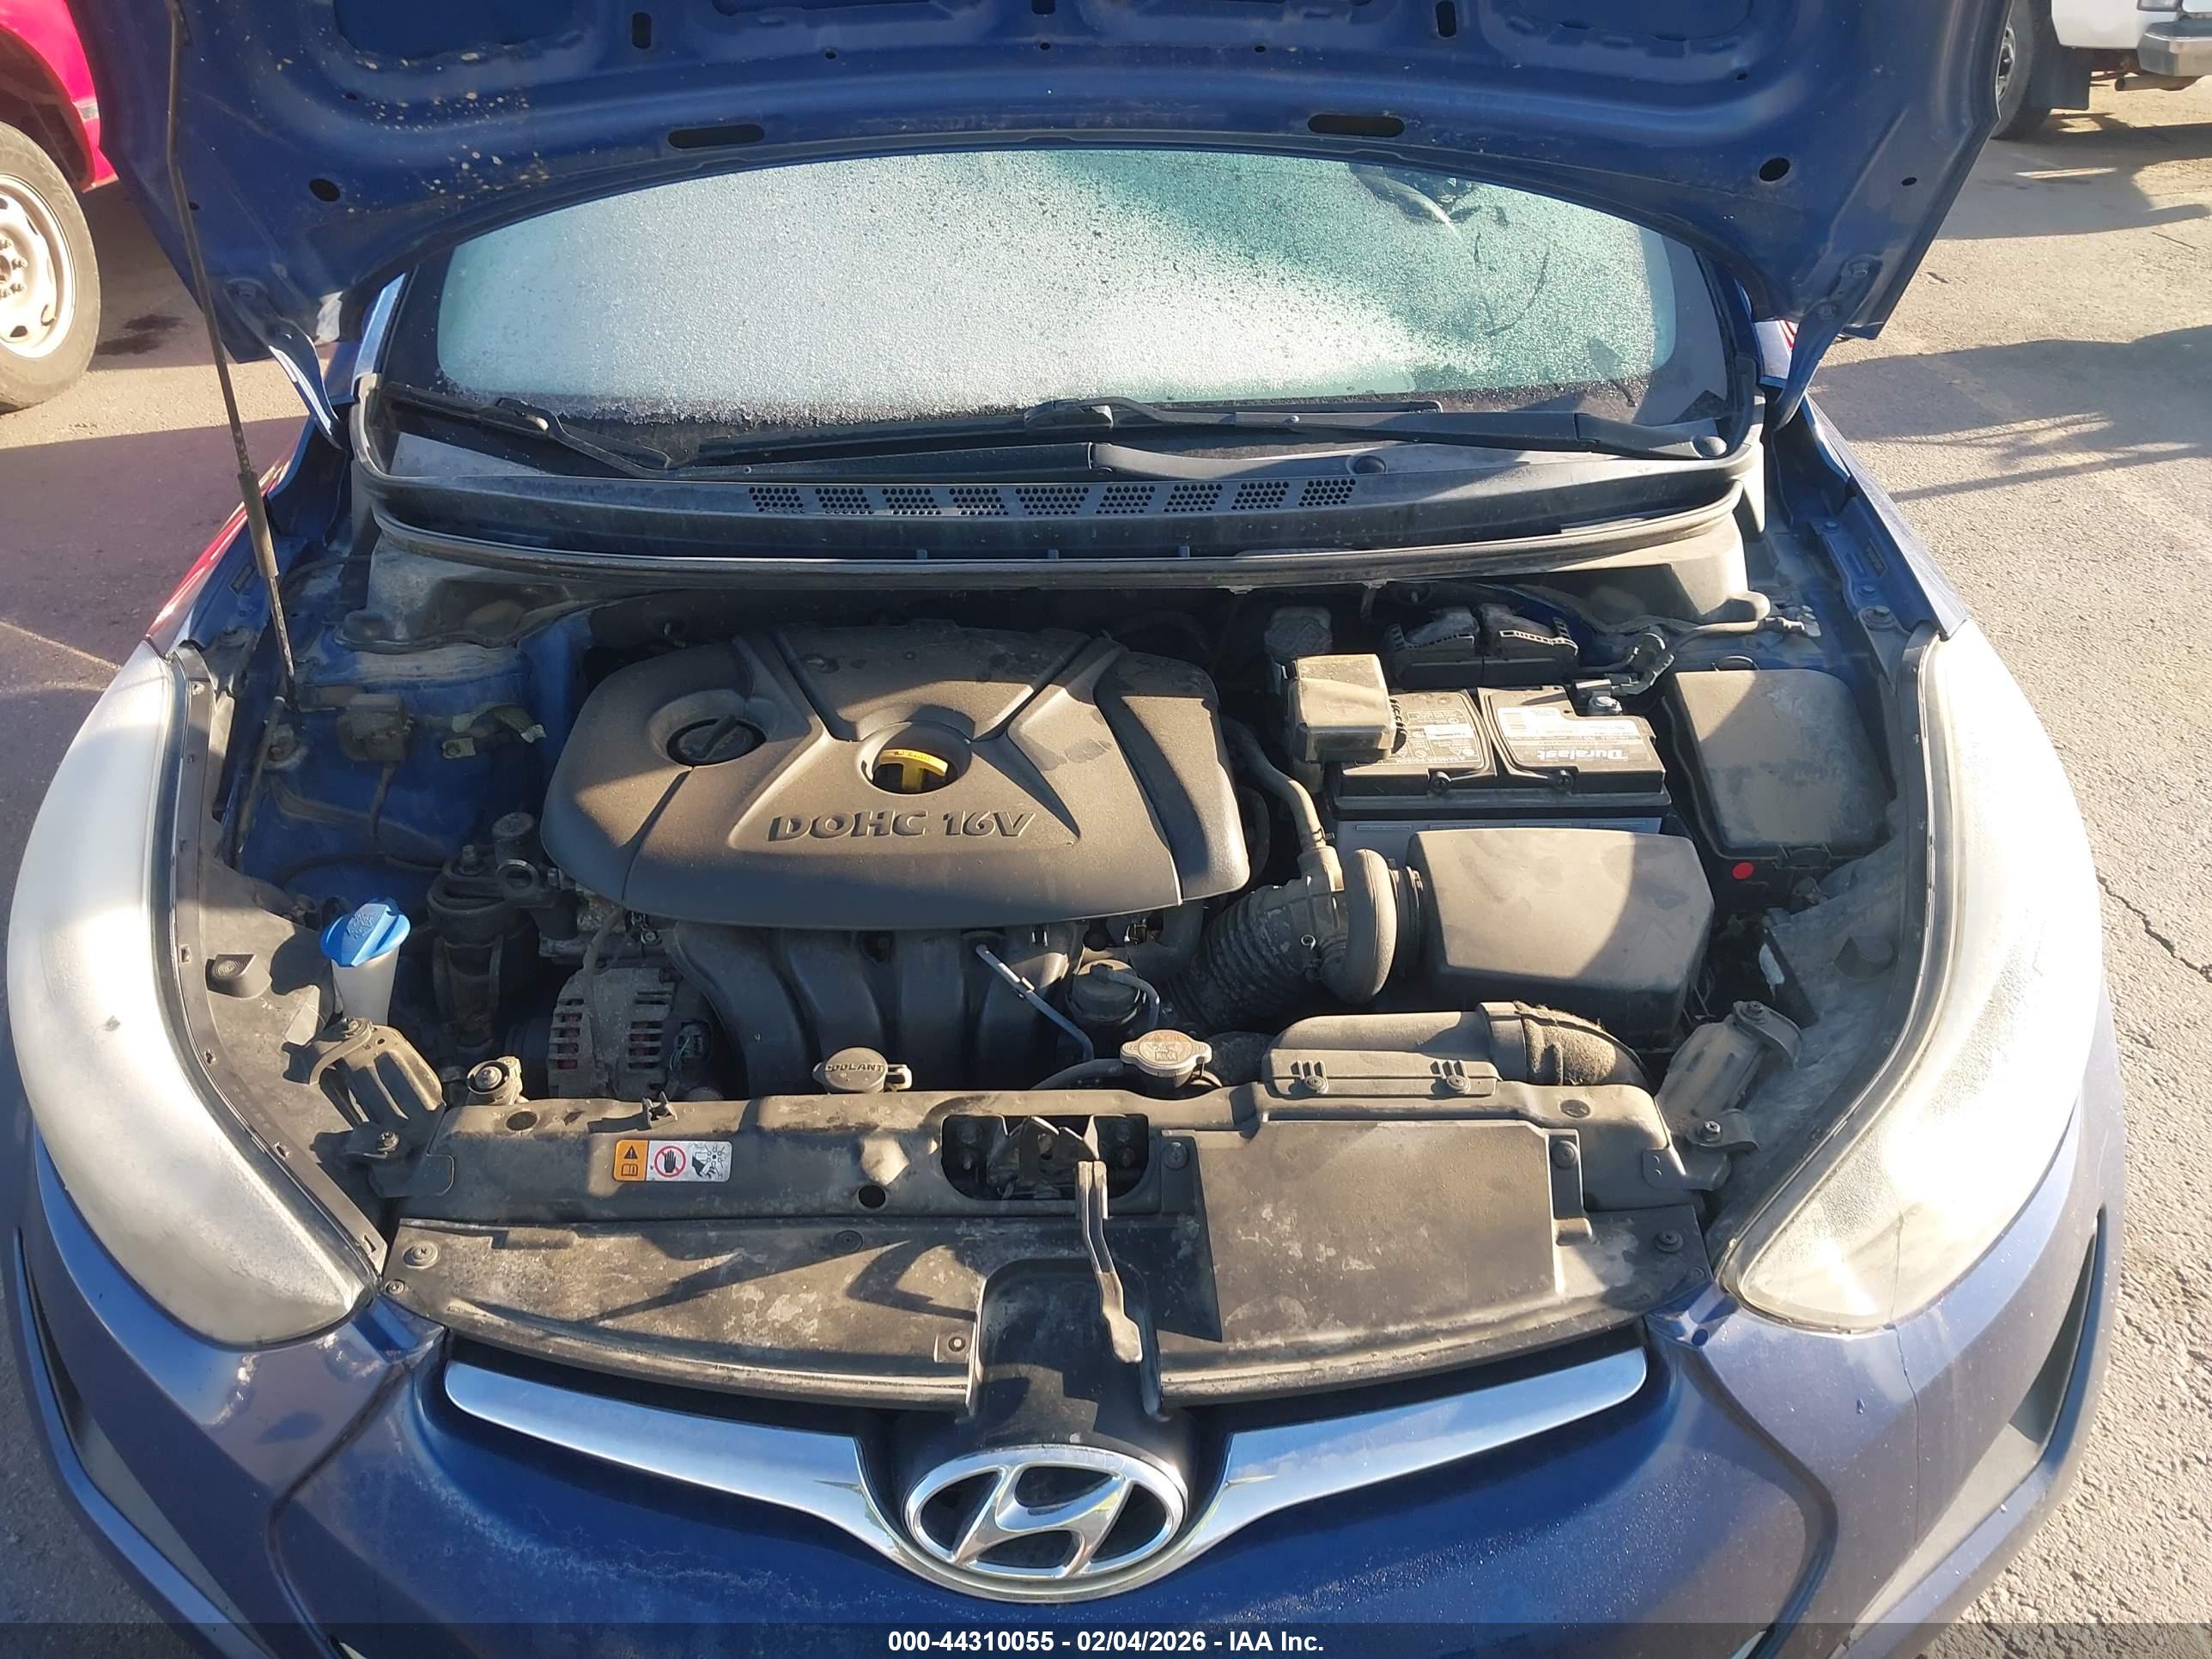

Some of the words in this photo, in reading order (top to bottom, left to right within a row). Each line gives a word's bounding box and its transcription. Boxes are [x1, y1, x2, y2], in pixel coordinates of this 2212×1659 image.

[1537, 749, 1629, 761] Duralast
[768, 810, 928, 842] DOHC
[943, 810, 1036, 837] 16V
[825, 1062, 885, 1073] COOLANT
